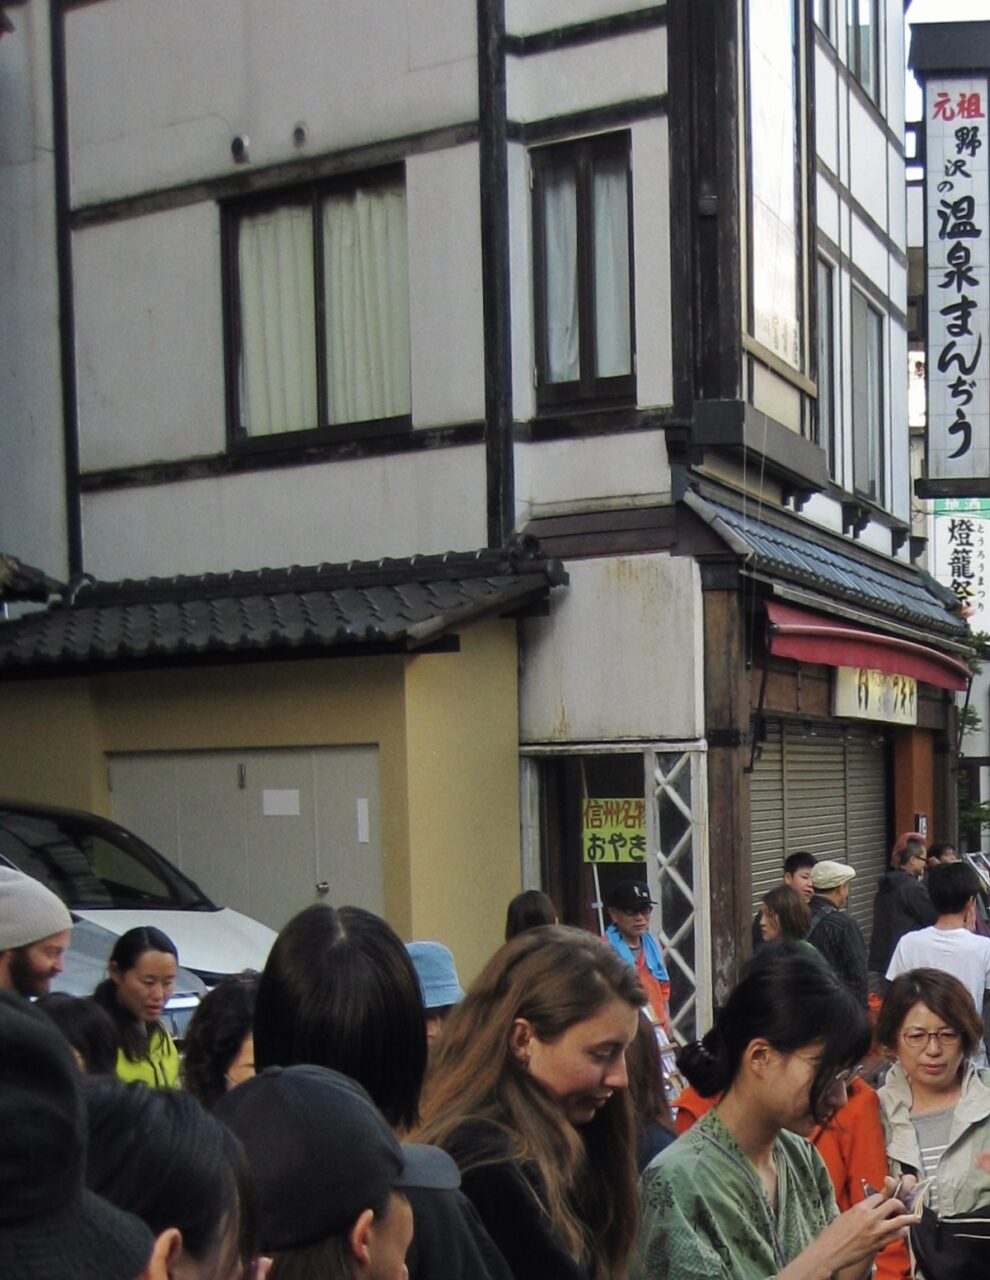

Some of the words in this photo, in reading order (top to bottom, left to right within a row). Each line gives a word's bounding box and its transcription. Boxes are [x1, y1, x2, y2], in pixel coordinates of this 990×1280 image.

[932, 92, 985, 121] 元祖
[937, 126, 982, 459] 野沢の温泉まんぢう
[977, 524, 986, 612] とうろうまつり
[587, 832, 646, 861] おやき
